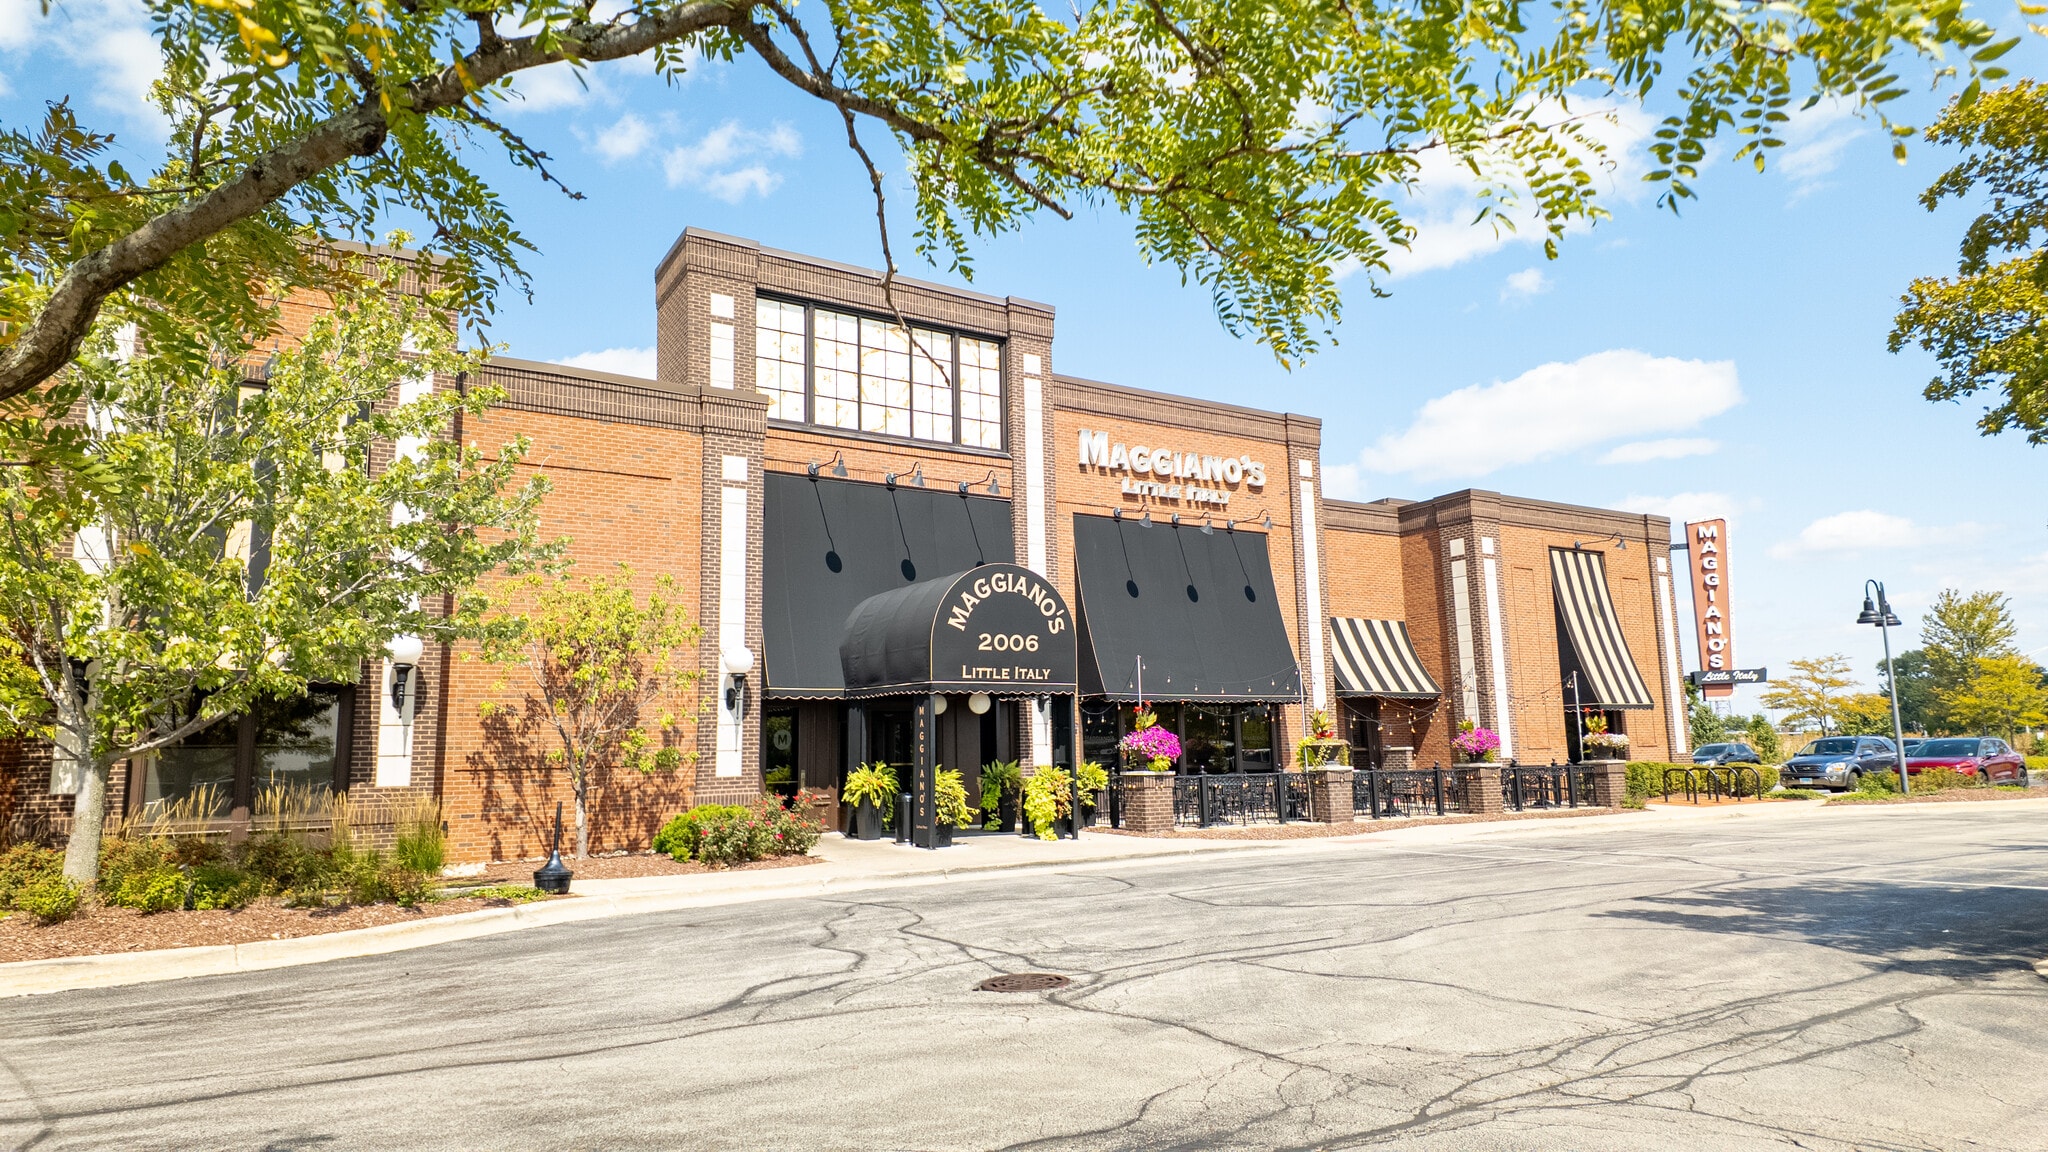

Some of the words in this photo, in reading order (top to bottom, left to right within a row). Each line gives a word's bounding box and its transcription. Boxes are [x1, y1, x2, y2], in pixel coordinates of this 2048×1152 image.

[1078, 429, 1267, 487] MAGGIANO'S
[1121, 476, 1181, 499] LITTLE
[1186, 484, 1232, 505] ITALY
[947, 572, 1065, 635] MAGGIANO'S
[1698, 525, 1728, 668] MAGGIANO'S
[978, 633, 1039, 652] 2006
[961, 665, 1010, 680] LITTLE
[1014, 666, 1051, 680] ITALY
[1701, 671, 1730, 682] Little
[1733, 670, 1759, 682] Italy
[777, 734, 788, 745] M
[918, 706, 926, 817] MAGGIANO'S
